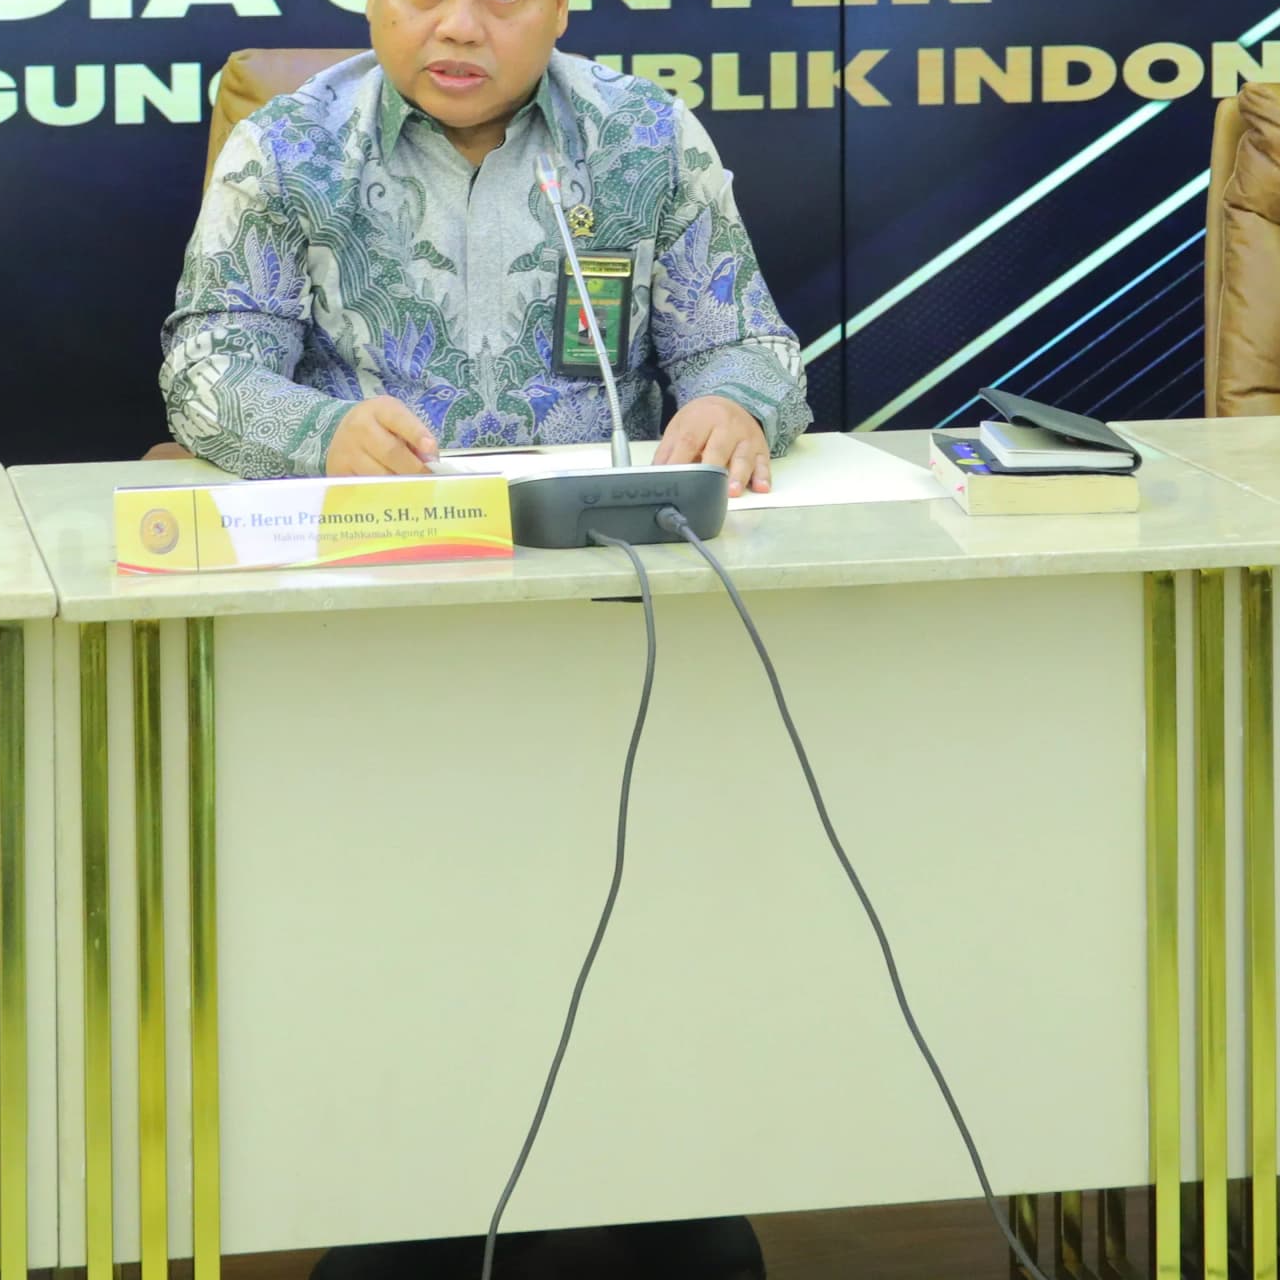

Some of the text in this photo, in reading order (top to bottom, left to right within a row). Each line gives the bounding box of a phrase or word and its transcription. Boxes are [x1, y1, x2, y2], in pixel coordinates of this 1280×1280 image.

[611, 482, 680, 500] BOSCH
[220, 506, 488, 529] Dr. Heru Pramono, S.H., M.Hum.
